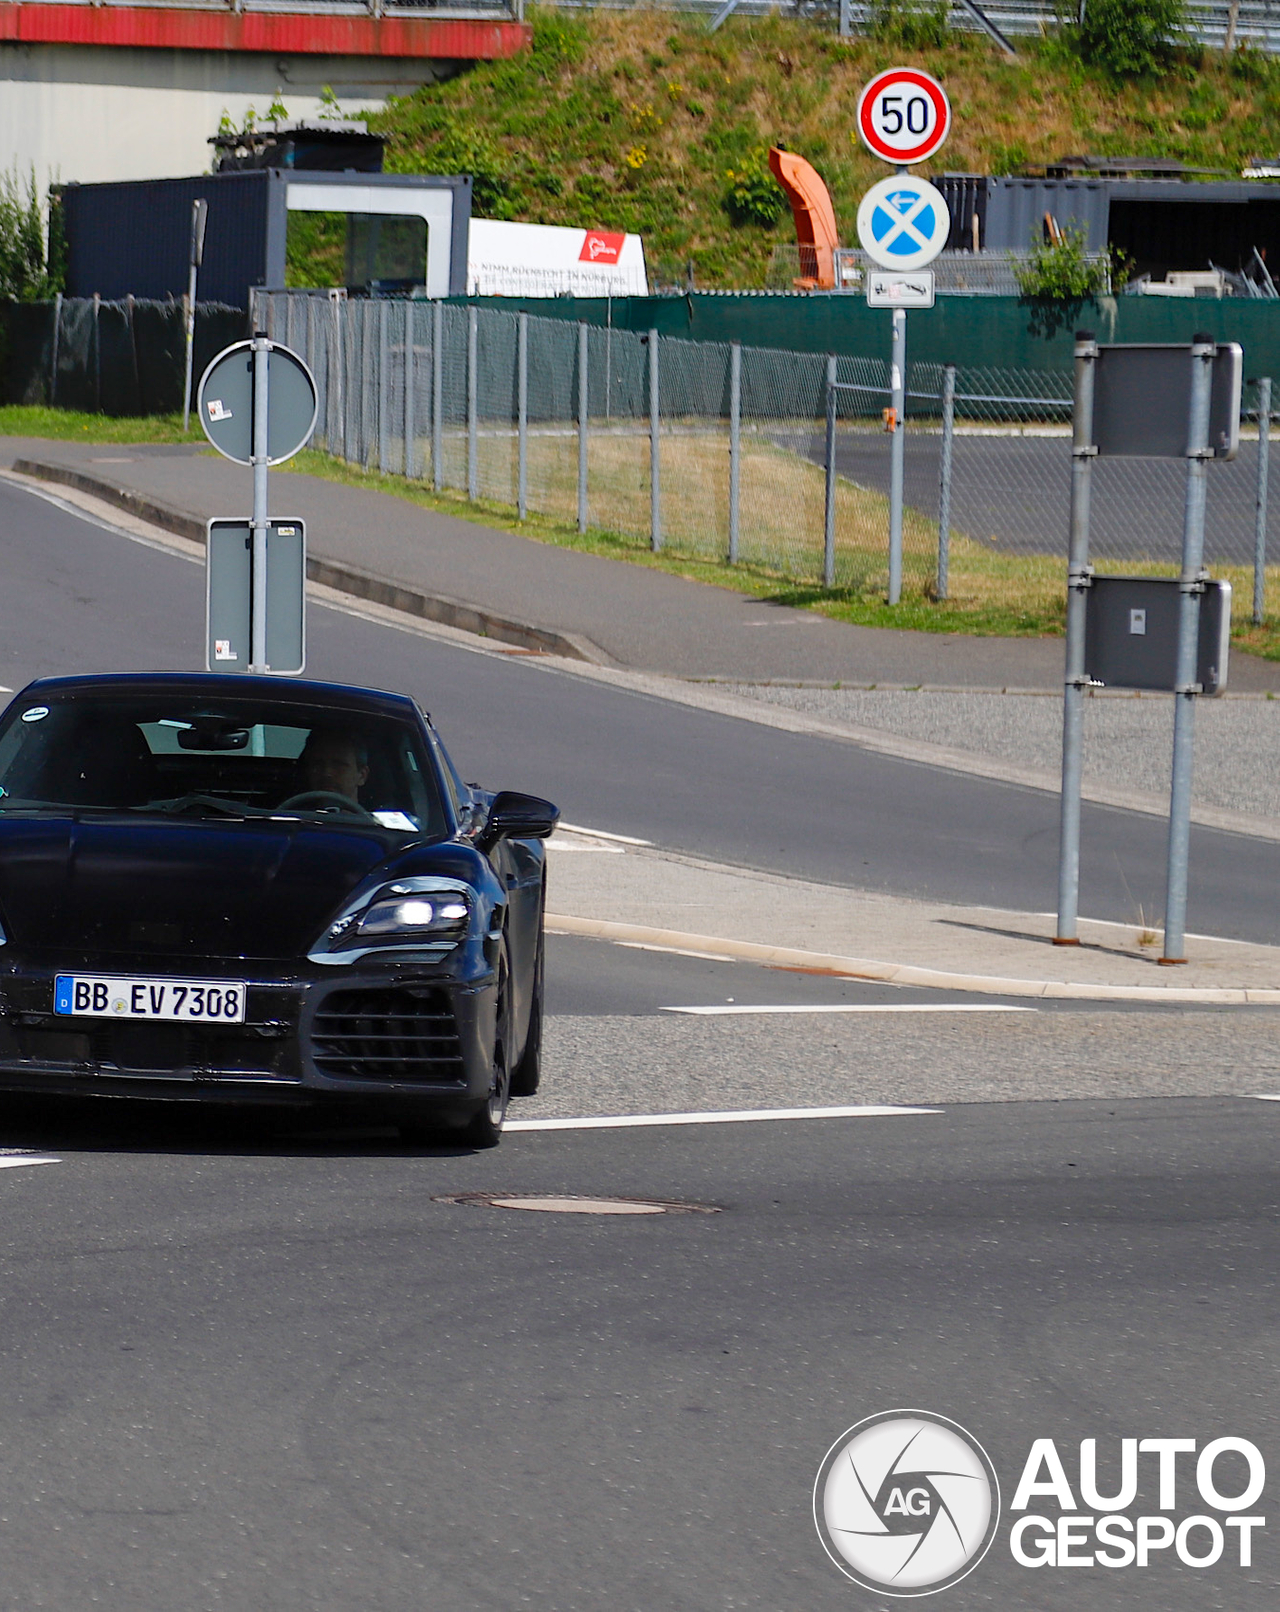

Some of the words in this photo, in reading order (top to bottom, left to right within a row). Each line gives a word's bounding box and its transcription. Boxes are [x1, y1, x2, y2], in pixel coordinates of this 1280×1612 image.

[882, 97, 928, 134] 50
[481, 263, 509, 273] NIMM
[60, 999, 68, 1008] D
[74, 982, 108, 1011] BB
[131, 985, 165, 1014] EV
[172, 986, 238, 1018] 7308
